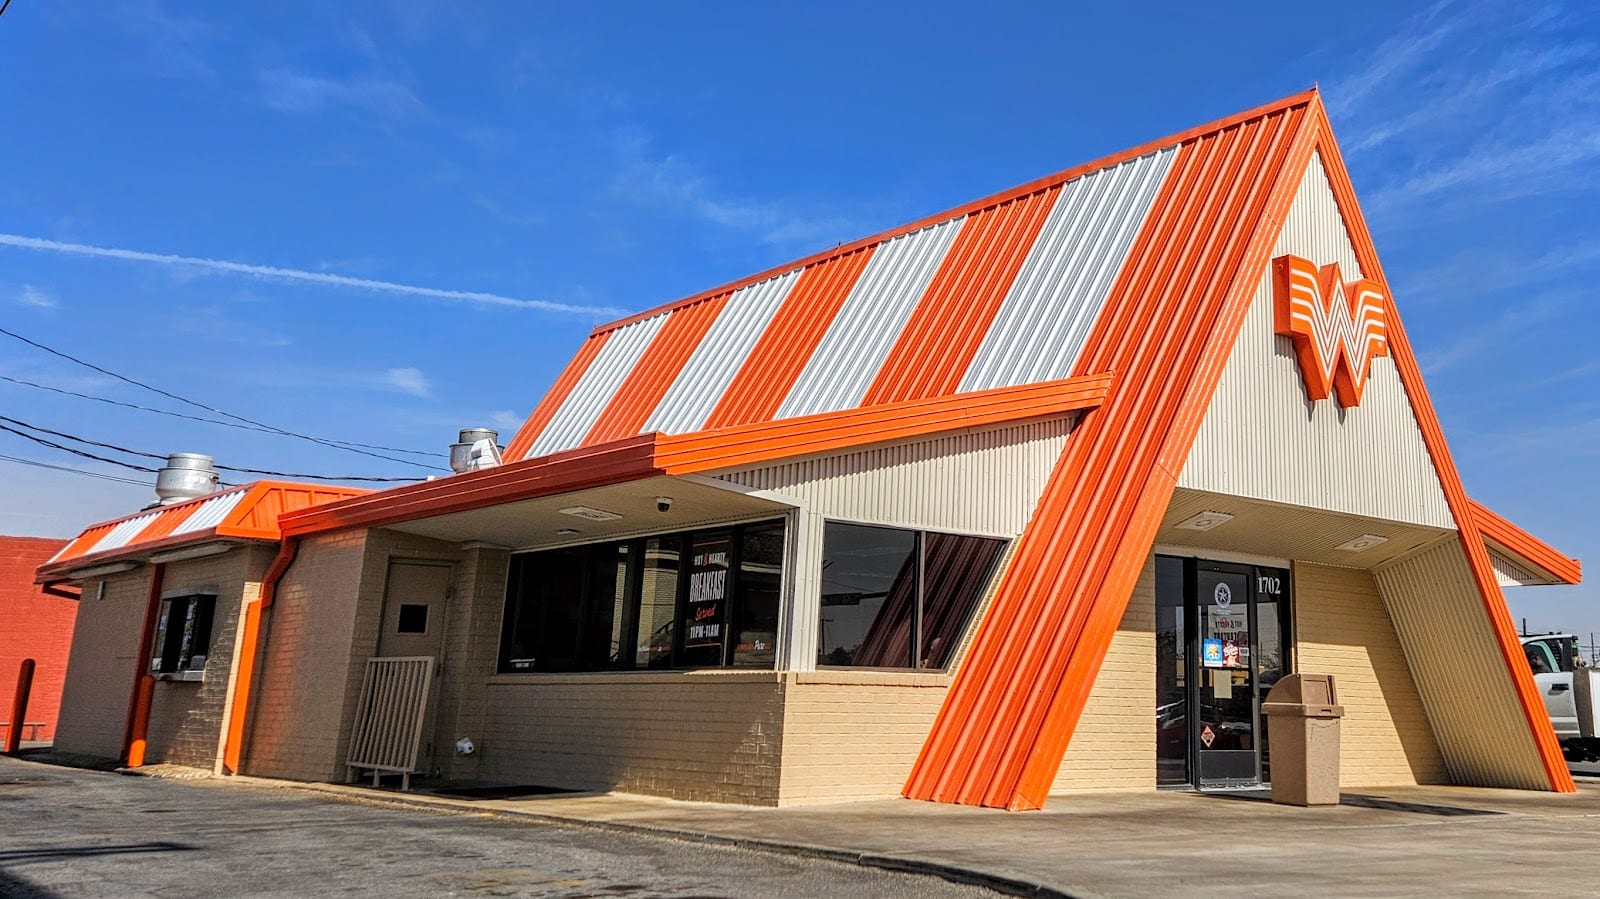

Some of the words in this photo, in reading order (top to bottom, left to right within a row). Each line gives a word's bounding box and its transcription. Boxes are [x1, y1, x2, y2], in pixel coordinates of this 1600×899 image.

[1275, 254, 1388, 408] W
[690, 570, 727, 602] BREAKFAST
[1258, 576, 1281, 594] 1702
